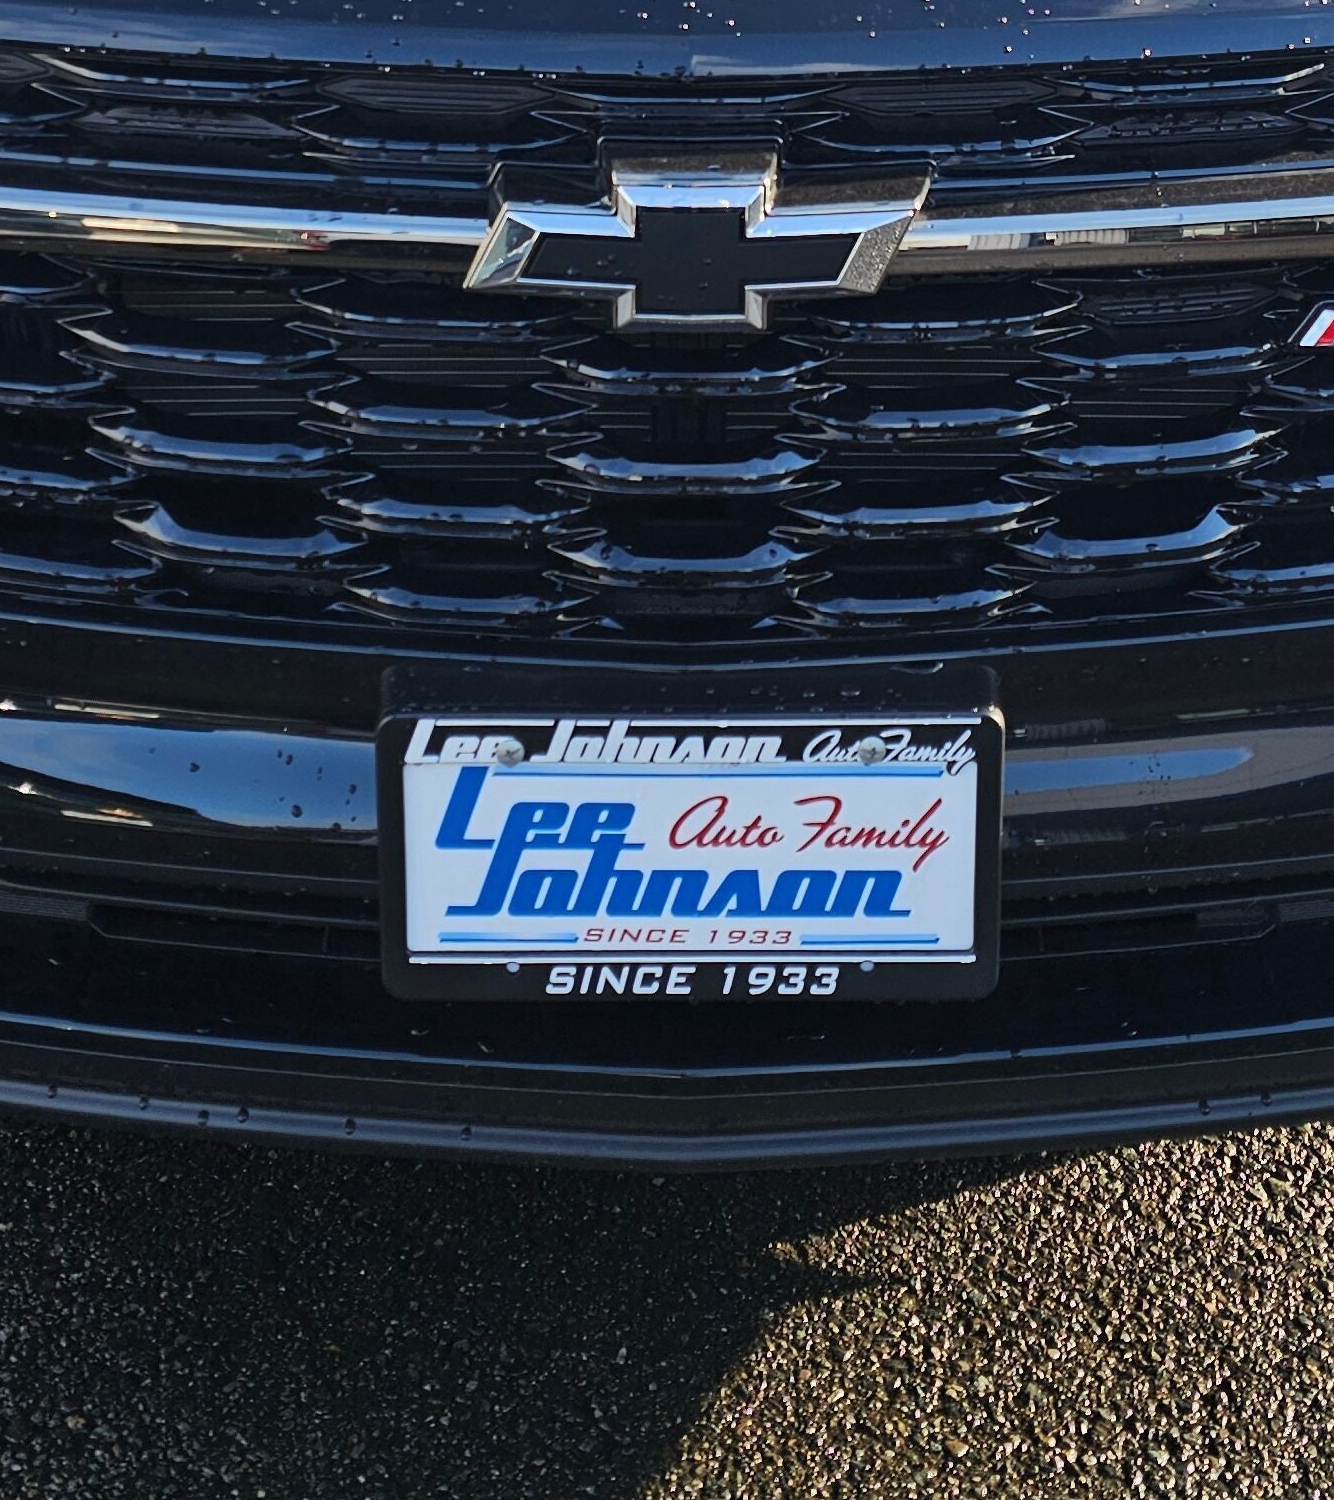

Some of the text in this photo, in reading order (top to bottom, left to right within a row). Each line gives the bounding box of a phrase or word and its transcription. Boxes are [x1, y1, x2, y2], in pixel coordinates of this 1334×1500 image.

[530, 718, 786, 763] Johnson
[802, 729, 882, 763] Aut
[878, 728, 976, 776] Family
[435, 766, 950, 873] Lee Auto Family
[445, 842, 912, 918] Johnson
[583, 928, 792, 945] SINCE 1933
[545, 966, 839, 996] SINCE 1933
